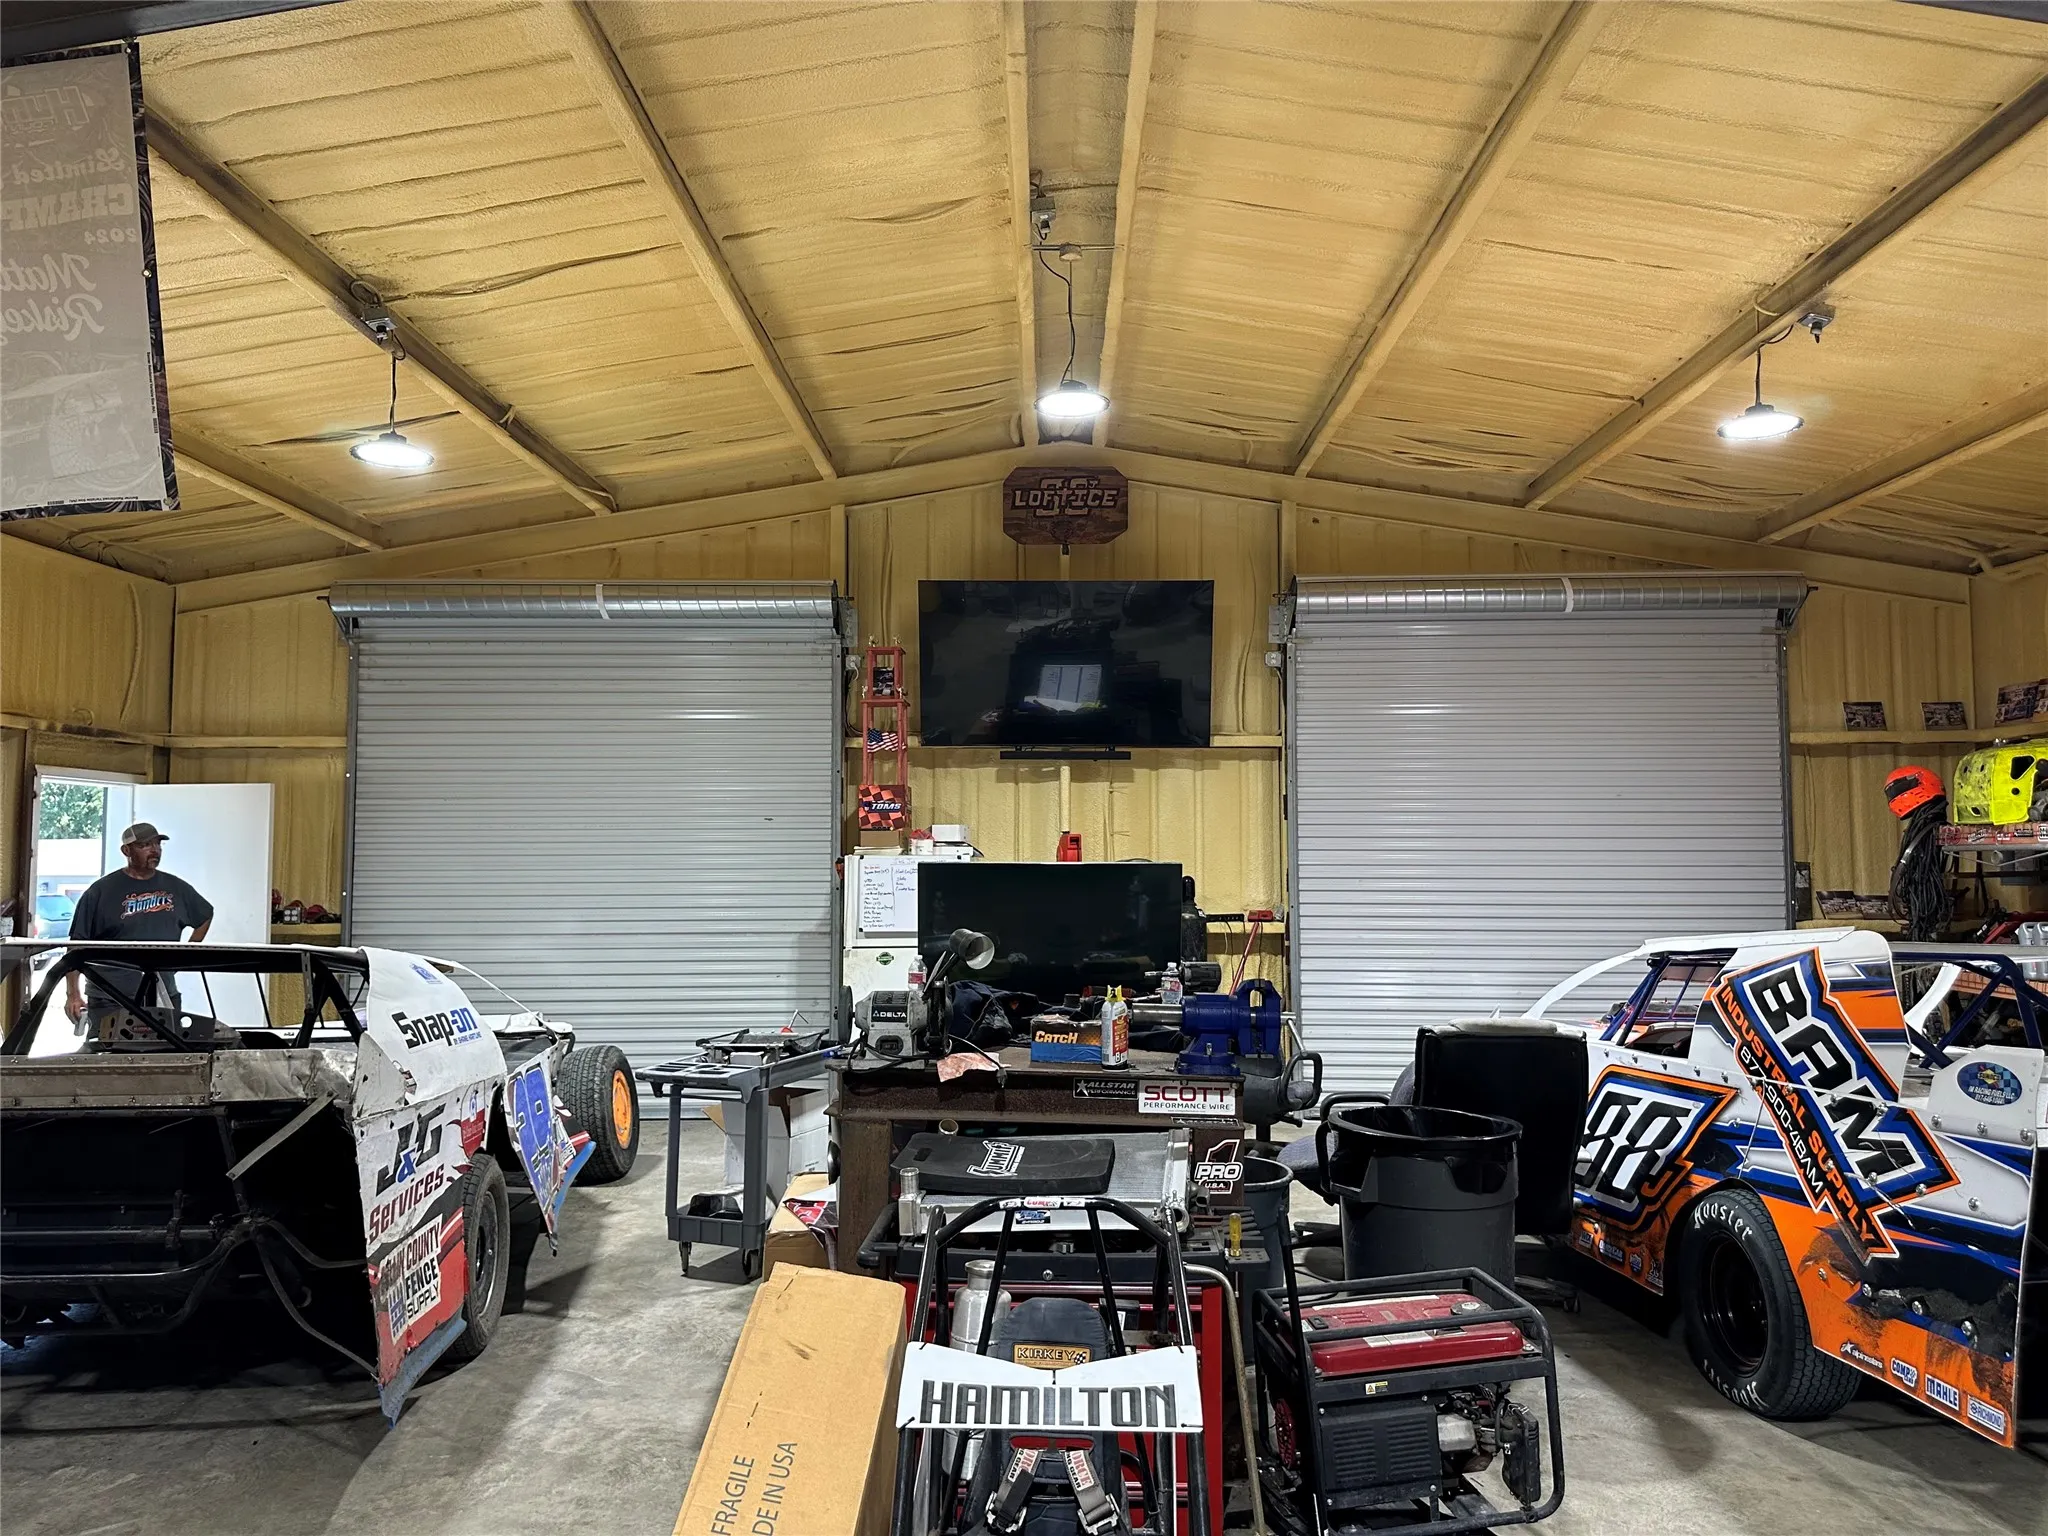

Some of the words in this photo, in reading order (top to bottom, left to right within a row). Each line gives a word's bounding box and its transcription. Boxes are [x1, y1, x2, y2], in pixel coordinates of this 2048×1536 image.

[391, 1007, 478, 1049] Snap-on
[1087, 1081, 1135, 1089] ALLSTAR
[1144, 1086, 1230, 1102] SCOTT
[1748, 966, 1916, 1182] BAM
[1143, 1102, 1207, 1110] PERFORMANCE
[1721, 987, 1807, 1129] INDUSTRIAL
[1808, 1130, 1875, 1241] SUPPLY
[1196, 1165, 1240, 1179] PRO
[369, 1163, 445, 1245] Services
[1694, 1200, 1753, 1241] Hoosier
[406, 1222, 440, 1271] COUNTY
[405, 1257, 439, 1300] FENCE
[406, 1281, 440, 1320] SUPPLY
[1017, 1348, 1075, 1360] KIRKEY
[919, 1379, 1178, 1428] HAMILTON
[1925, 1378, 1959, 1407] MAHLE
[768, 1443, 798, 1479] USA
[711, 1455, 755, 1536] FRAGILE
[761, 1483, 786, 1504] IN
